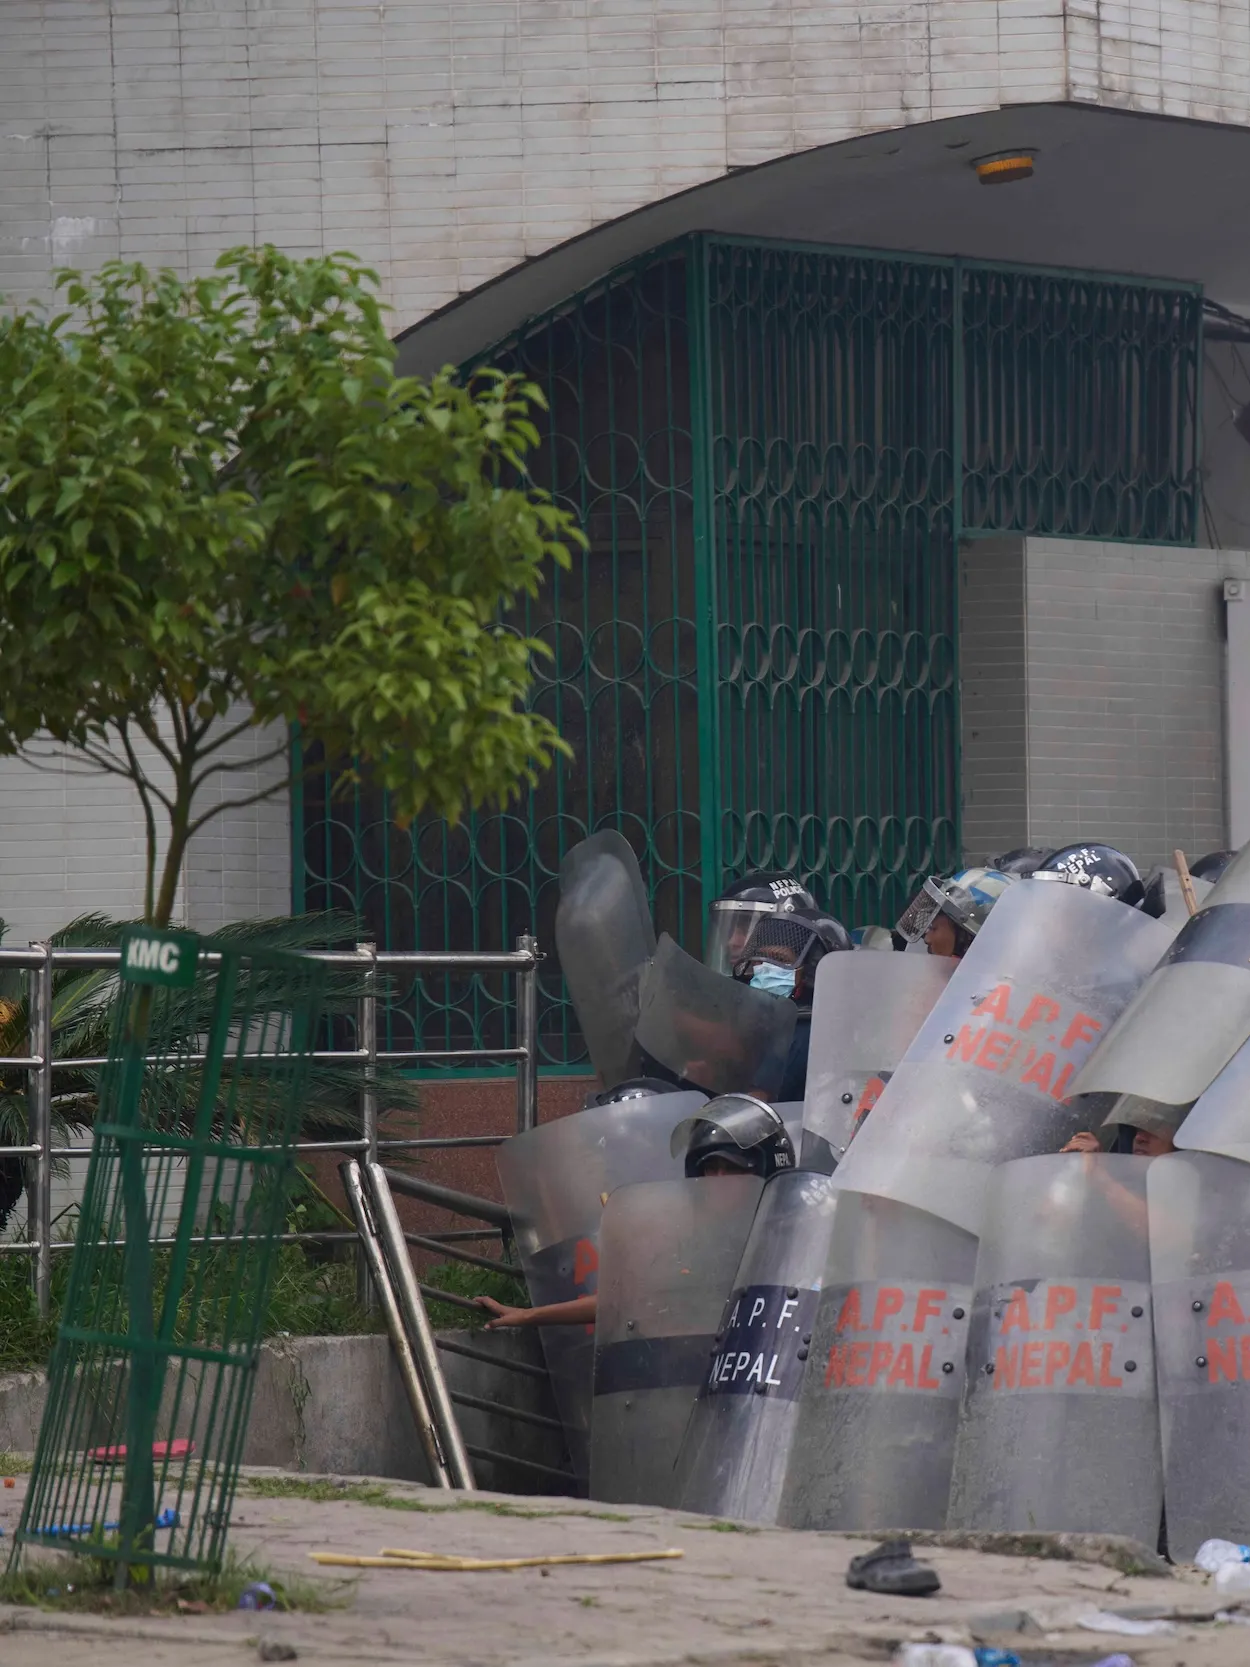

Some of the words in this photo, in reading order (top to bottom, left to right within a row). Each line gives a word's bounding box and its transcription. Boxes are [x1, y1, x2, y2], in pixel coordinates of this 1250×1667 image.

[1057, 848, 1096, 870] A.P.F.
[1065, 853, 1102, 874] EPAL
[772, 885, 805, 899] POLICE
[945, 1024, 1071, 1106] NEPAL
[728, 1297, 800, 1332] A.P.F.
[835, 1287, 949, 1335] A.P.F.
[1000, 1286, 1128, 1335] A.P.F.
[709, 1352, 782, 1386] NEPAL
[823, 1341, 941, 1390] NEPAL
[992, 1340, 1124, 1391] NEPAL
